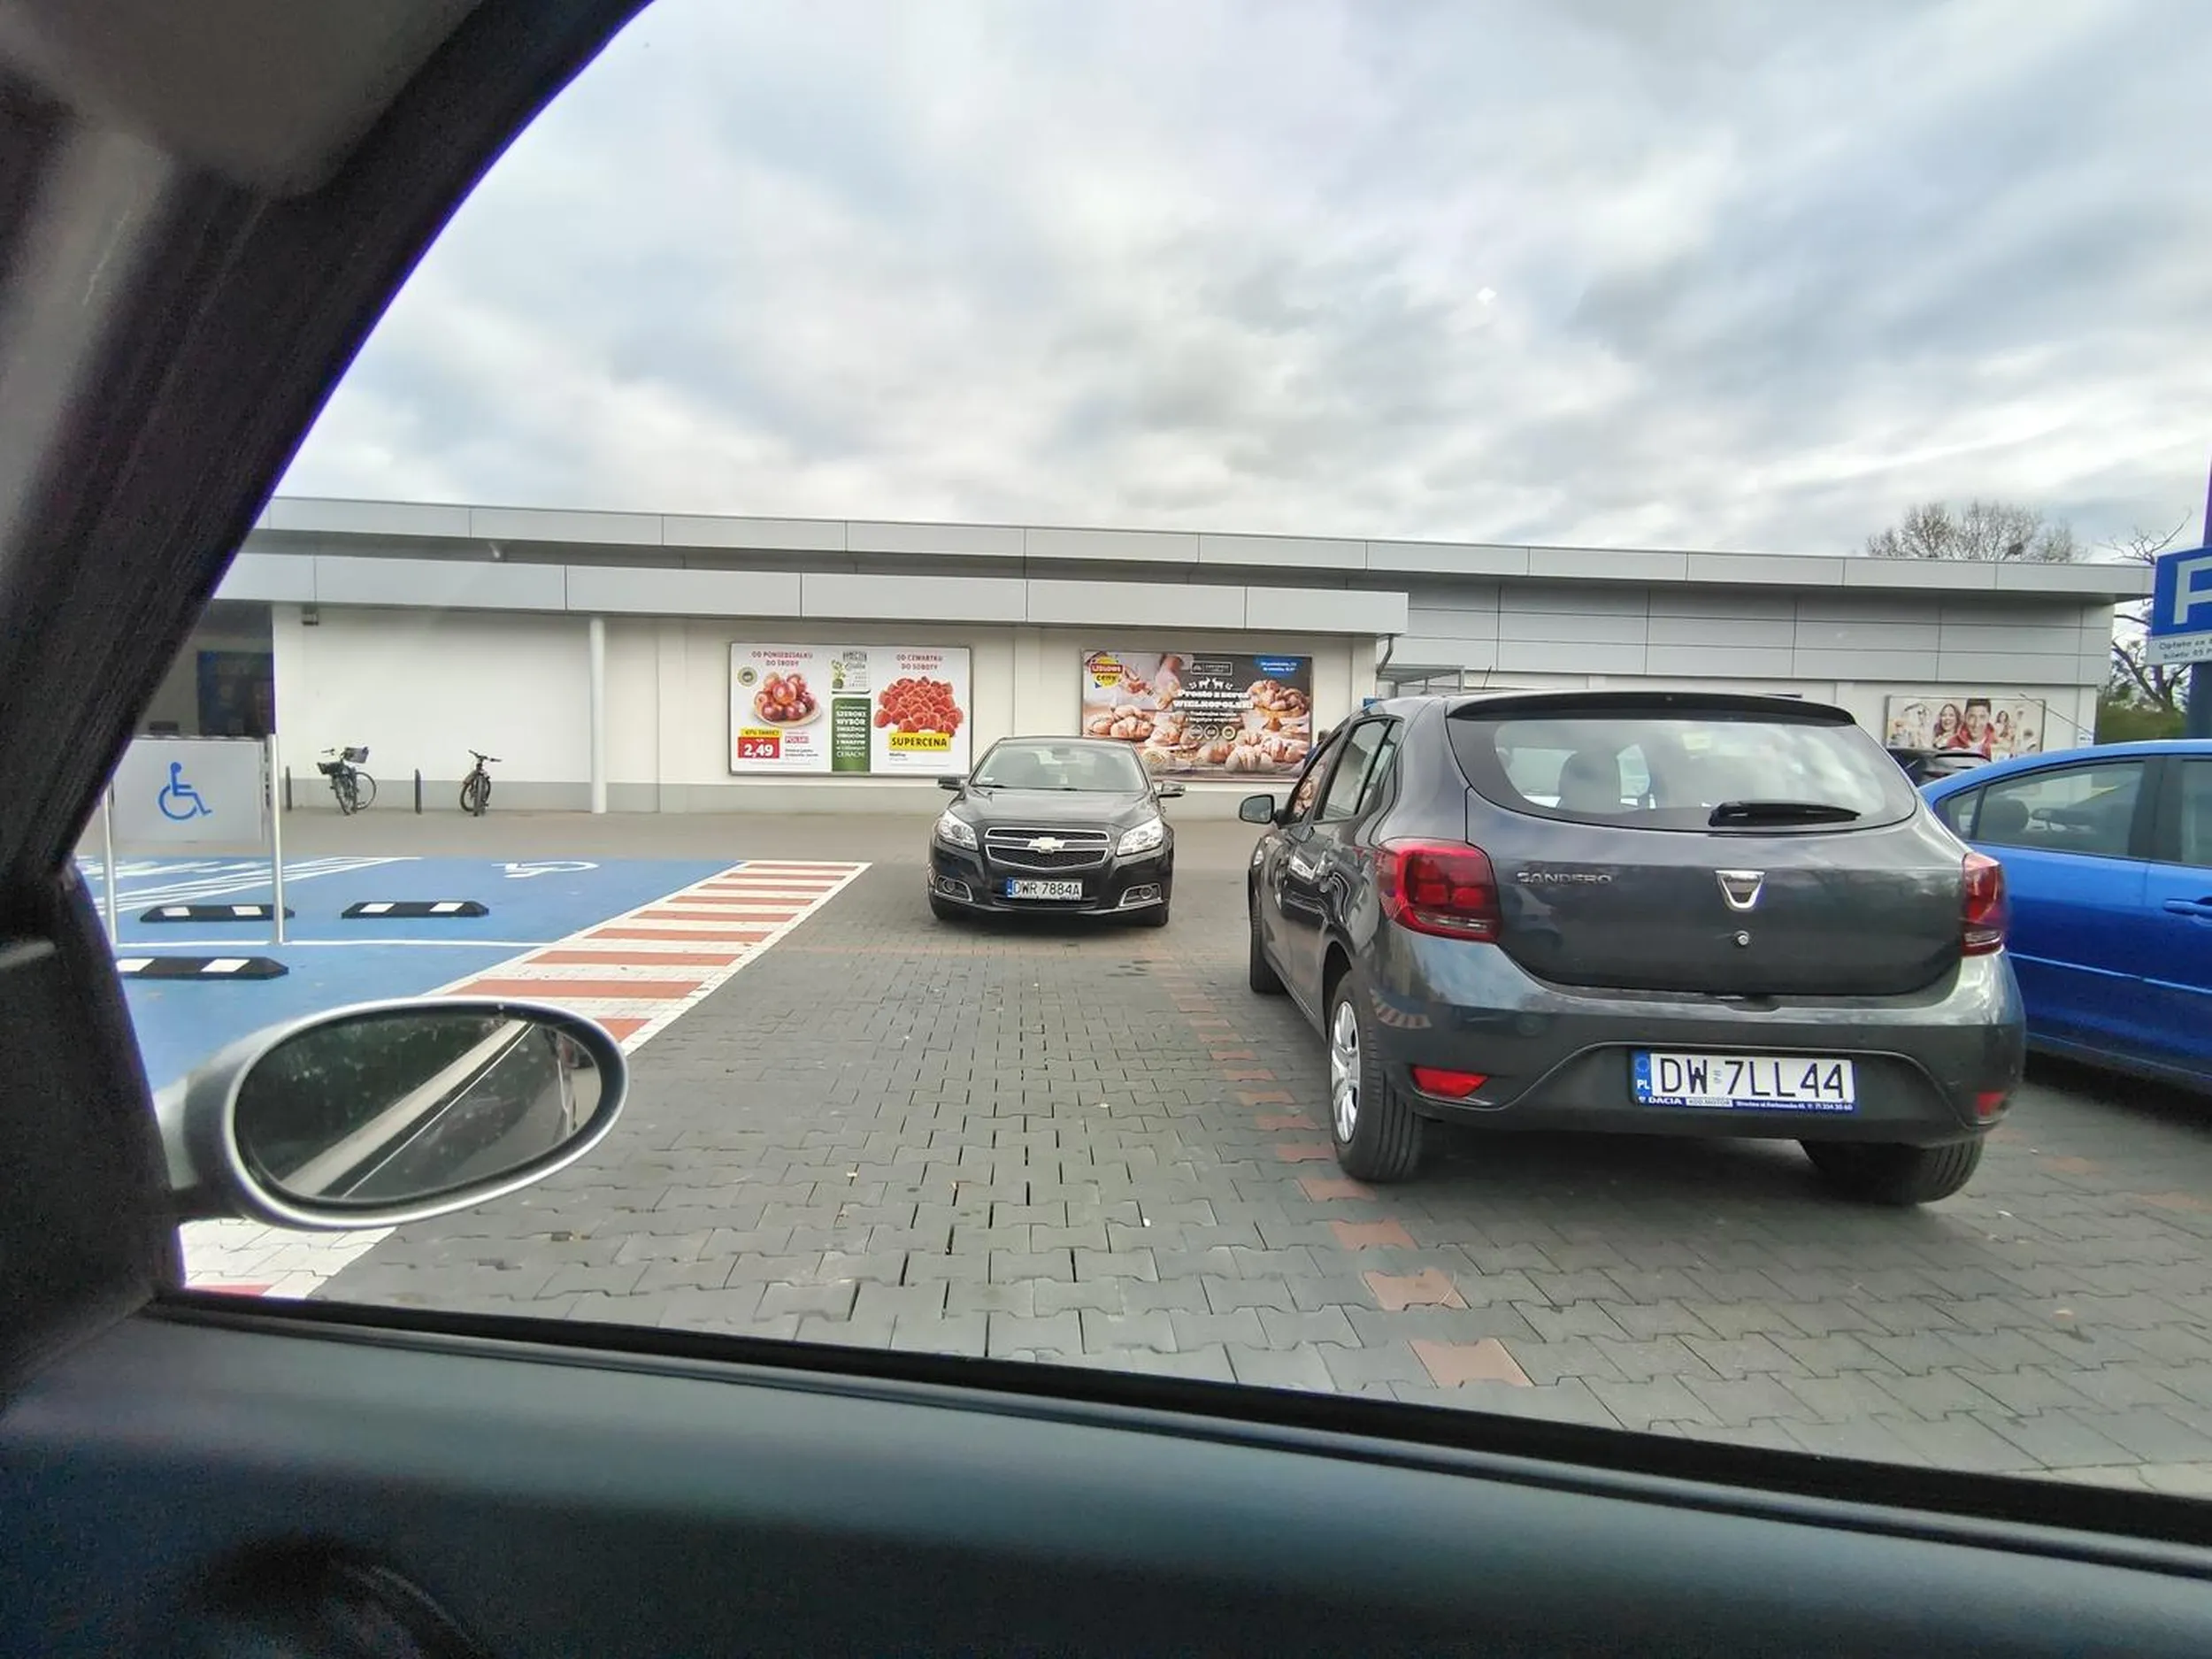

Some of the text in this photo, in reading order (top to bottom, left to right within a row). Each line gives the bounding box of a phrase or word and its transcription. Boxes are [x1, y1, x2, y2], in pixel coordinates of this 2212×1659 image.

[892, 736, 947, 747] SUPERCENA
[744, 743, 773, 757] 2,49
[1517, 872, 1612, 885] SANDERO
[1013, 881, 1079, 895] DWR 7884A
[1636, 1079, 1650, 1090] PL
[1660, 1058, 1846, 1100] DW 7LL44
[1648, 1097, 1683, 1106] DACIA
